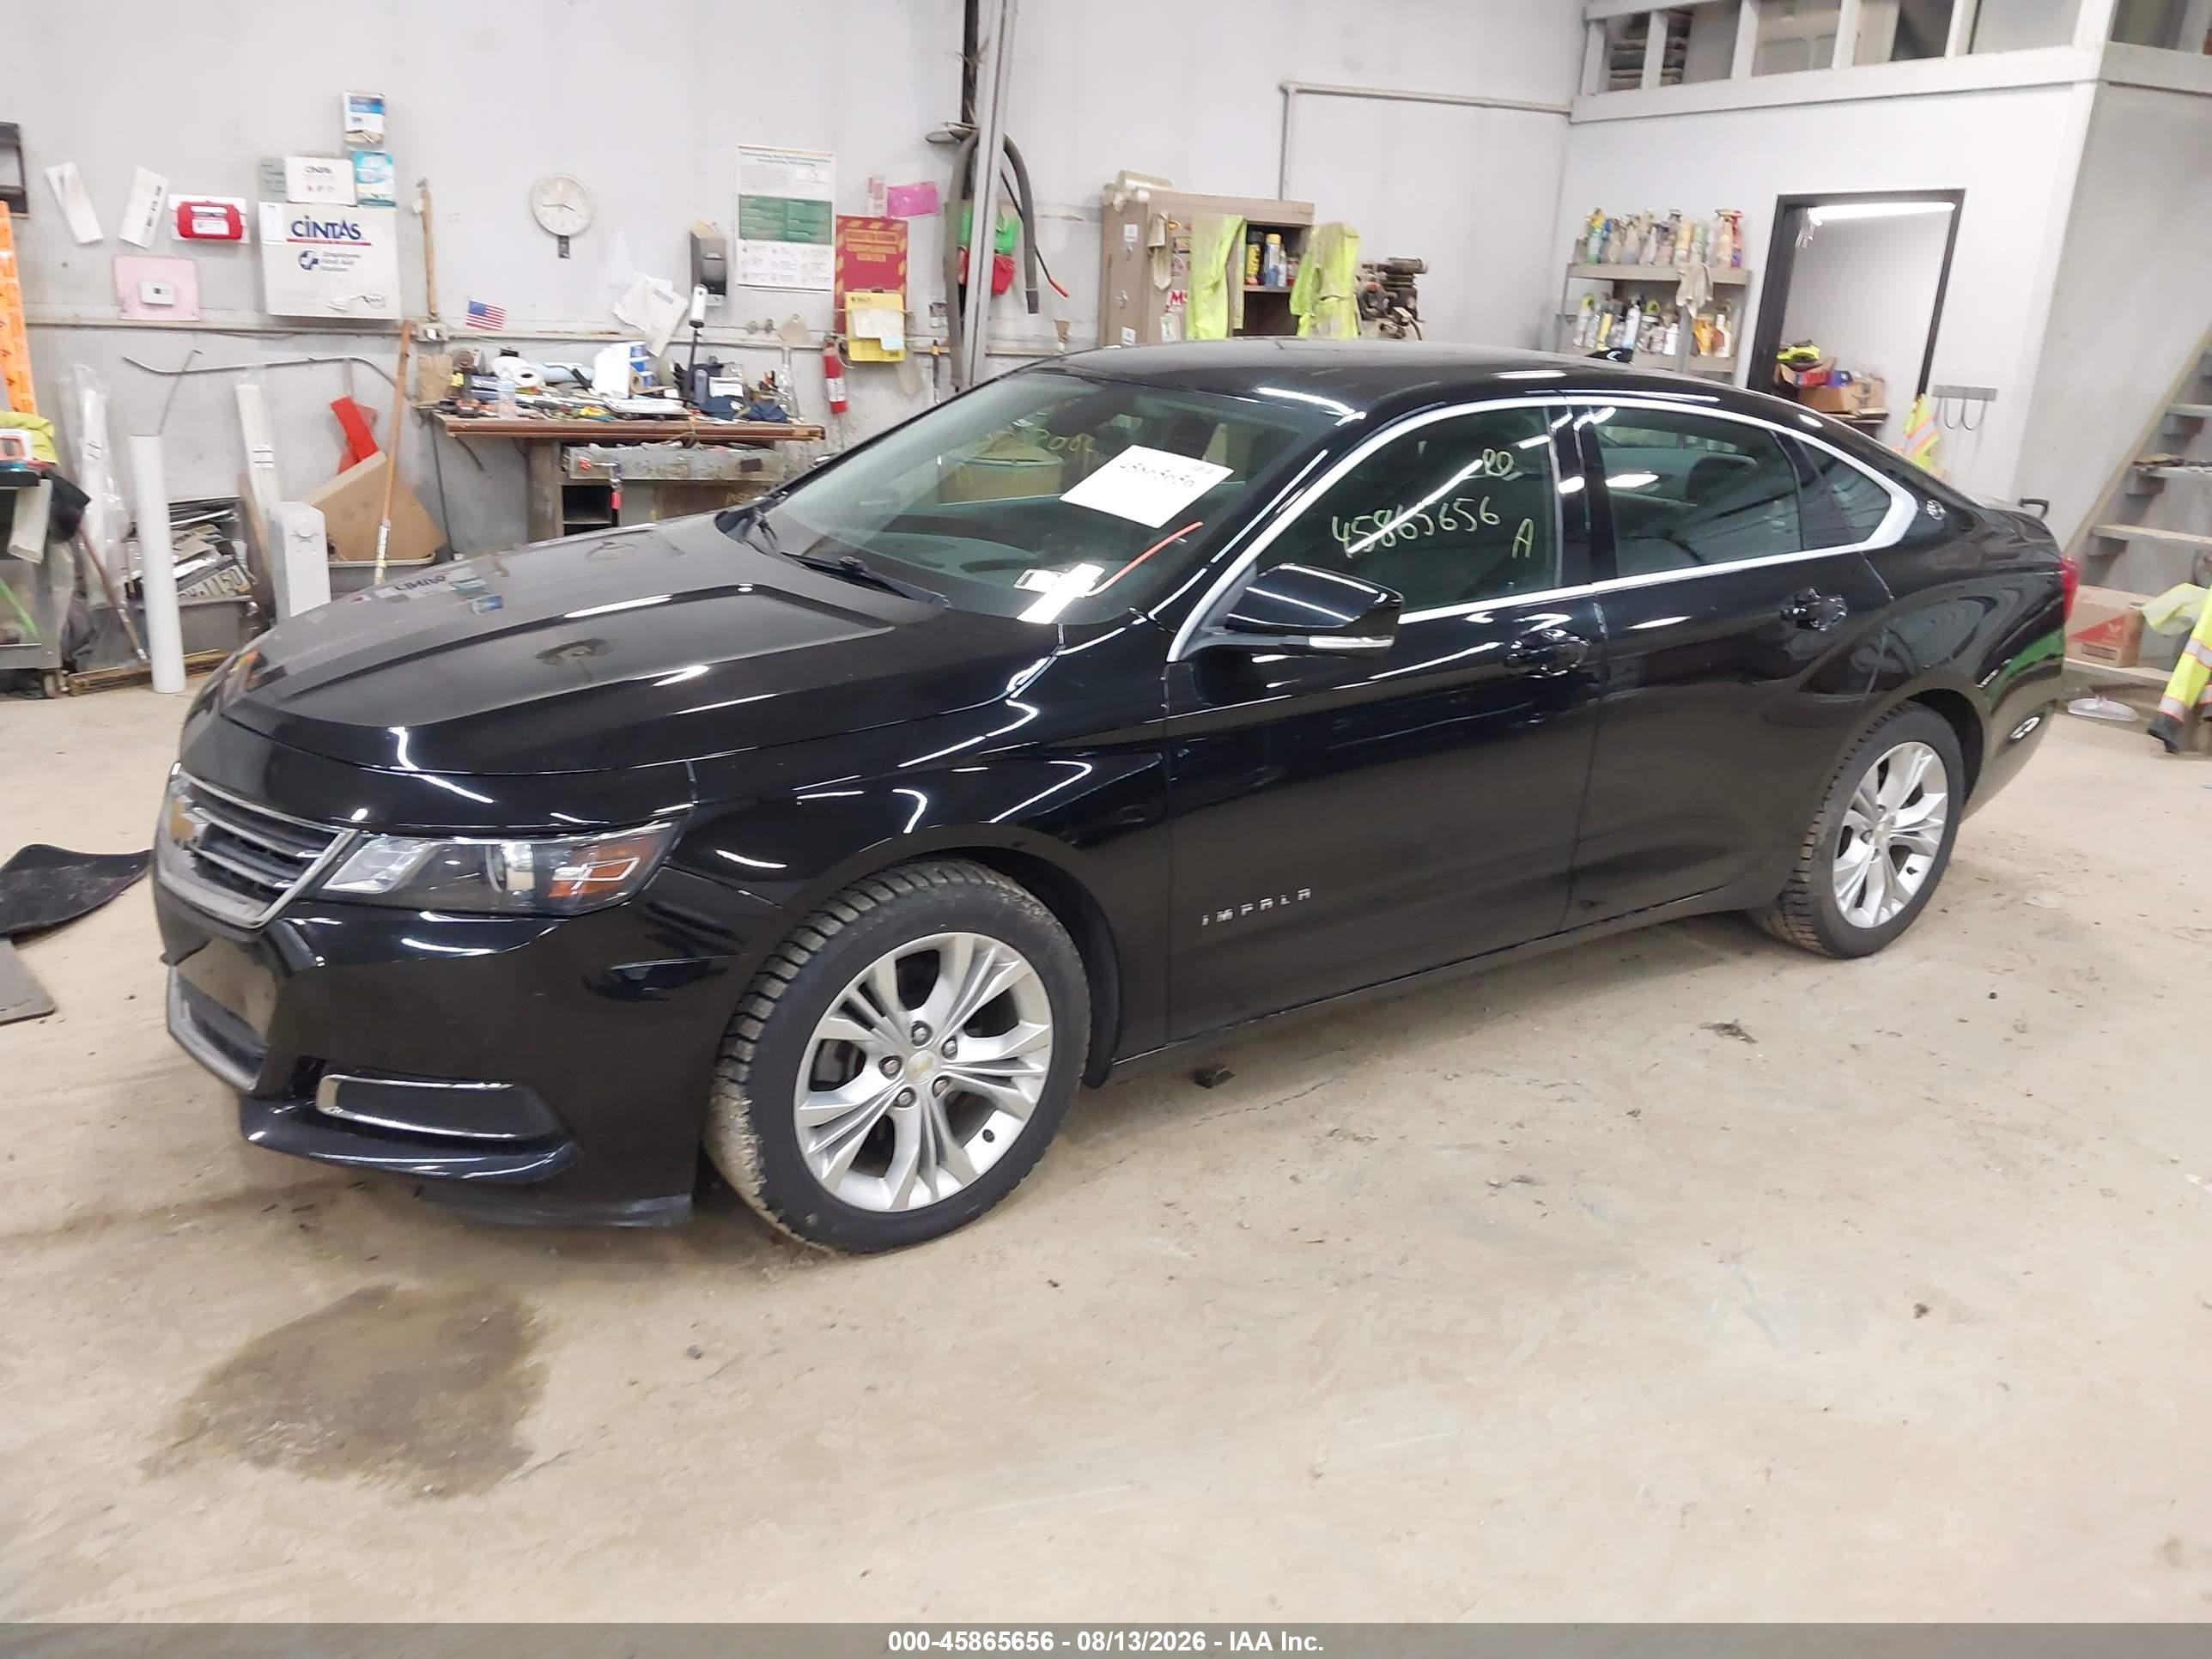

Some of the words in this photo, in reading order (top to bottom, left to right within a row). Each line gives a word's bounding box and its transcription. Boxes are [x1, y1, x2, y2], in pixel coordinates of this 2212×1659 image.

[291, 214, 362, 240] CINTAS
[1511, 518, 1534, 558] A
[1200, 887, 1312, 927] IMPALA
